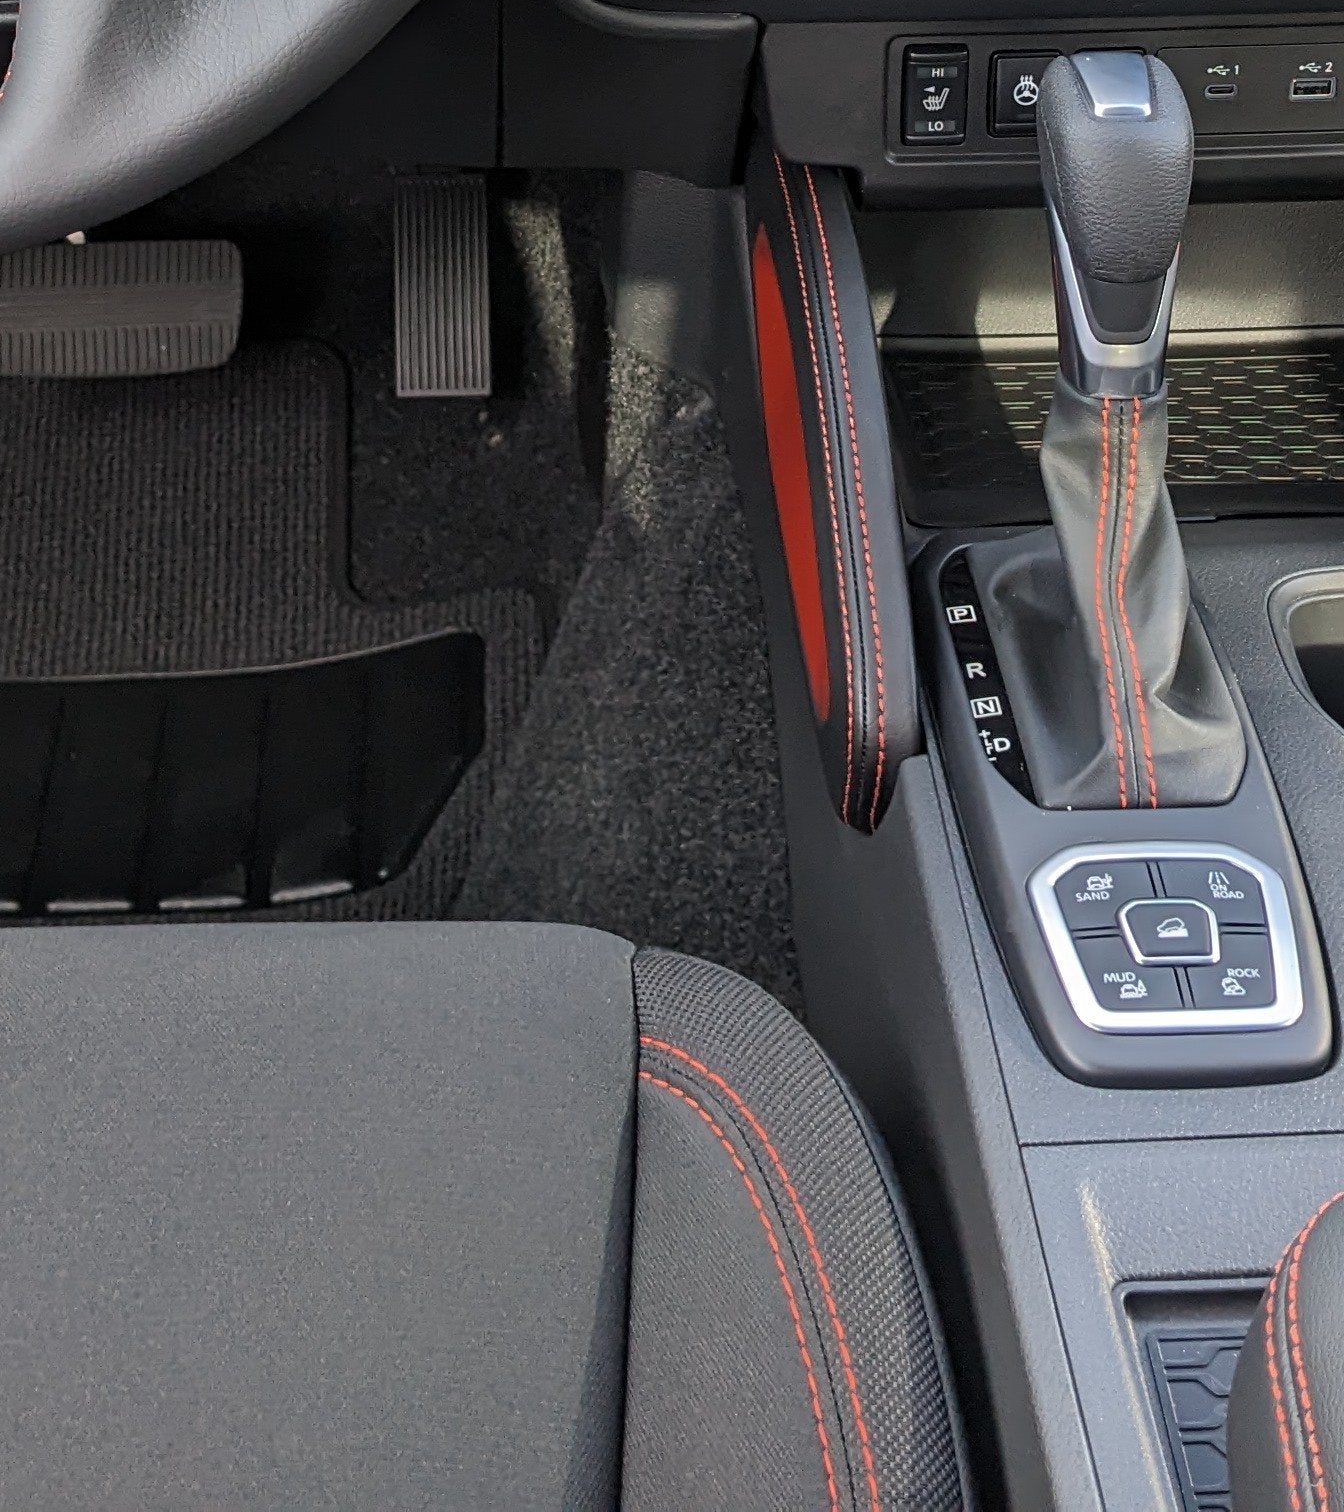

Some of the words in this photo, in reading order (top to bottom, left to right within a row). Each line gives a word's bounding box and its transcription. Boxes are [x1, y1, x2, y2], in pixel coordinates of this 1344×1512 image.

[931, 67, 945, 78] HI
[1234, 64, 1241, 76] 1
[1325, 61, 1334, 73] 2
[927, 121, 945, 132] LO
[953, 608, 969, 622] P
[966, 662, 987, 680] R
[977, 701, 996, 715] N
[993, 737, 1011, 753] D
[1210, 884, 1228, 893] ON
[1213, 889, 1245, 900] ROAD
[1075, 890, 1110, 902] SAND
[1103, 972, 1136, 983] MUD
[1227, 967, 1260, 979] ROCK
